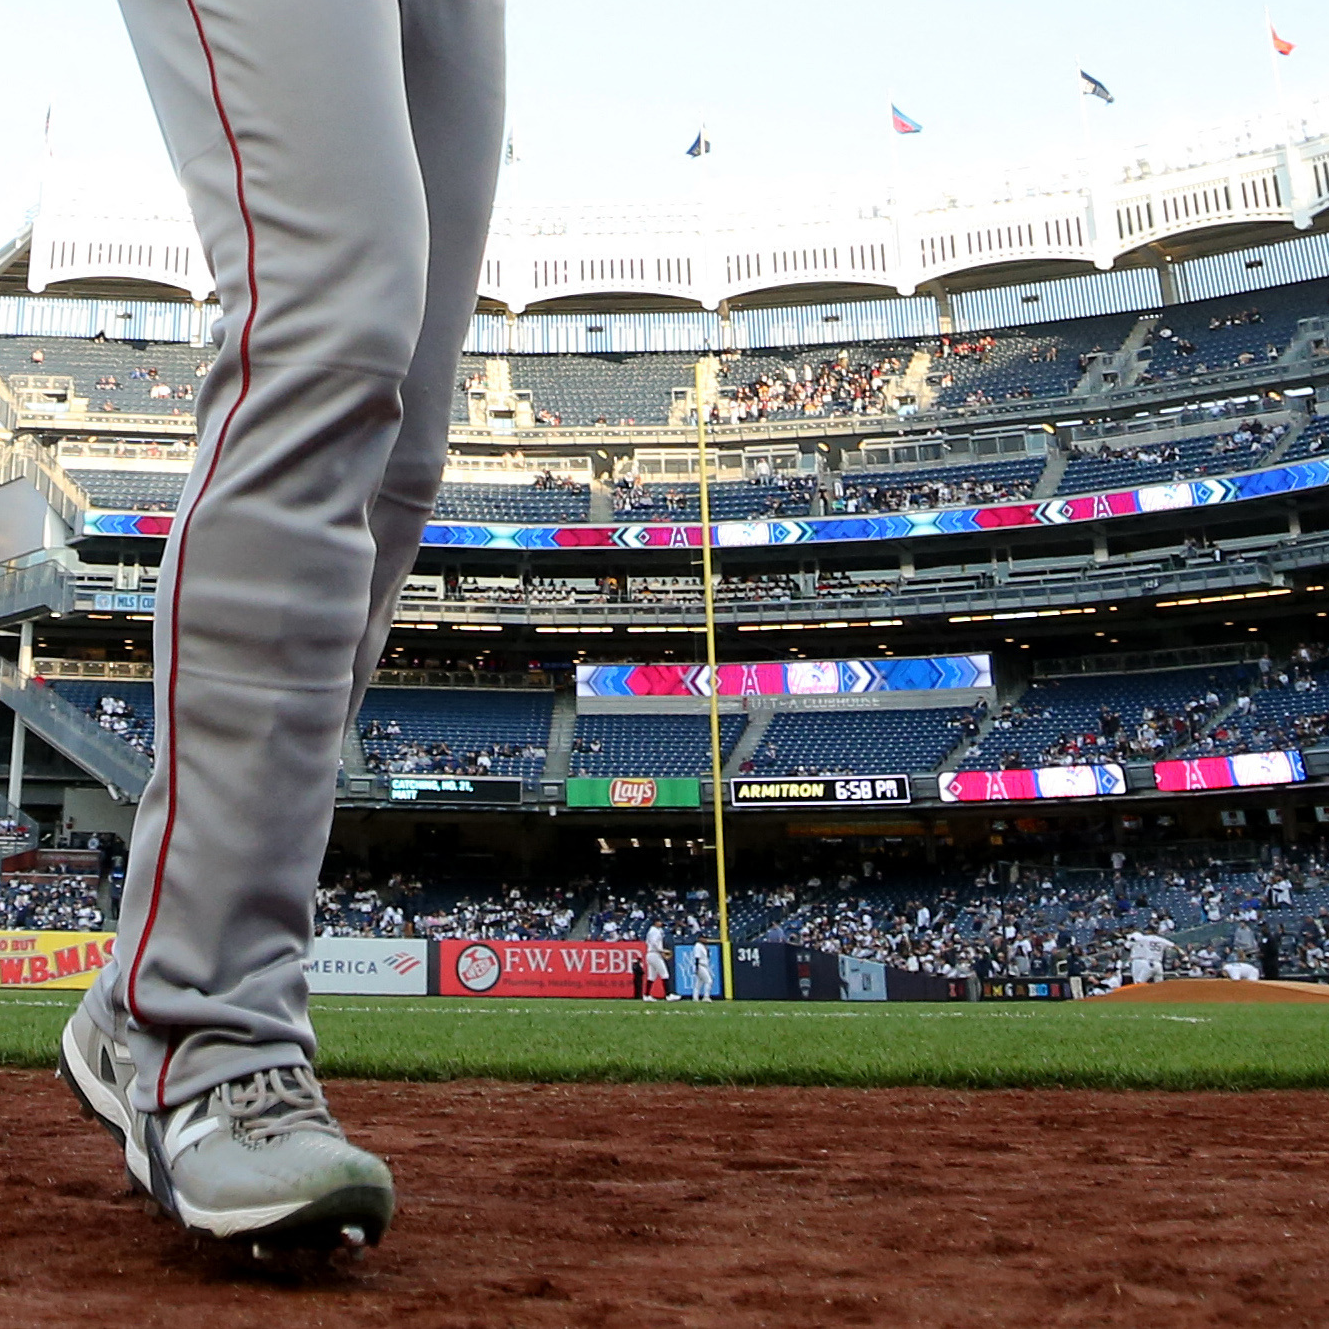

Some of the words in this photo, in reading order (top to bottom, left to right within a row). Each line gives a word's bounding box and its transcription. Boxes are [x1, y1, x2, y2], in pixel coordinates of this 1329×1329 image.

[142, 597, 155, 609] CU
[613, 779, 654, 806] Lay's
[738, 783, 825, 799] ARMITRON
[834, 780, 873, 800] 6:58
[874, 779, 899, 798] PM
[10, 938, 38, 952] BUT
[503, 947, 553, 973] F.W.
[737, 947, 760, 962] 314
[302, 959, 378, 975] MERICA
